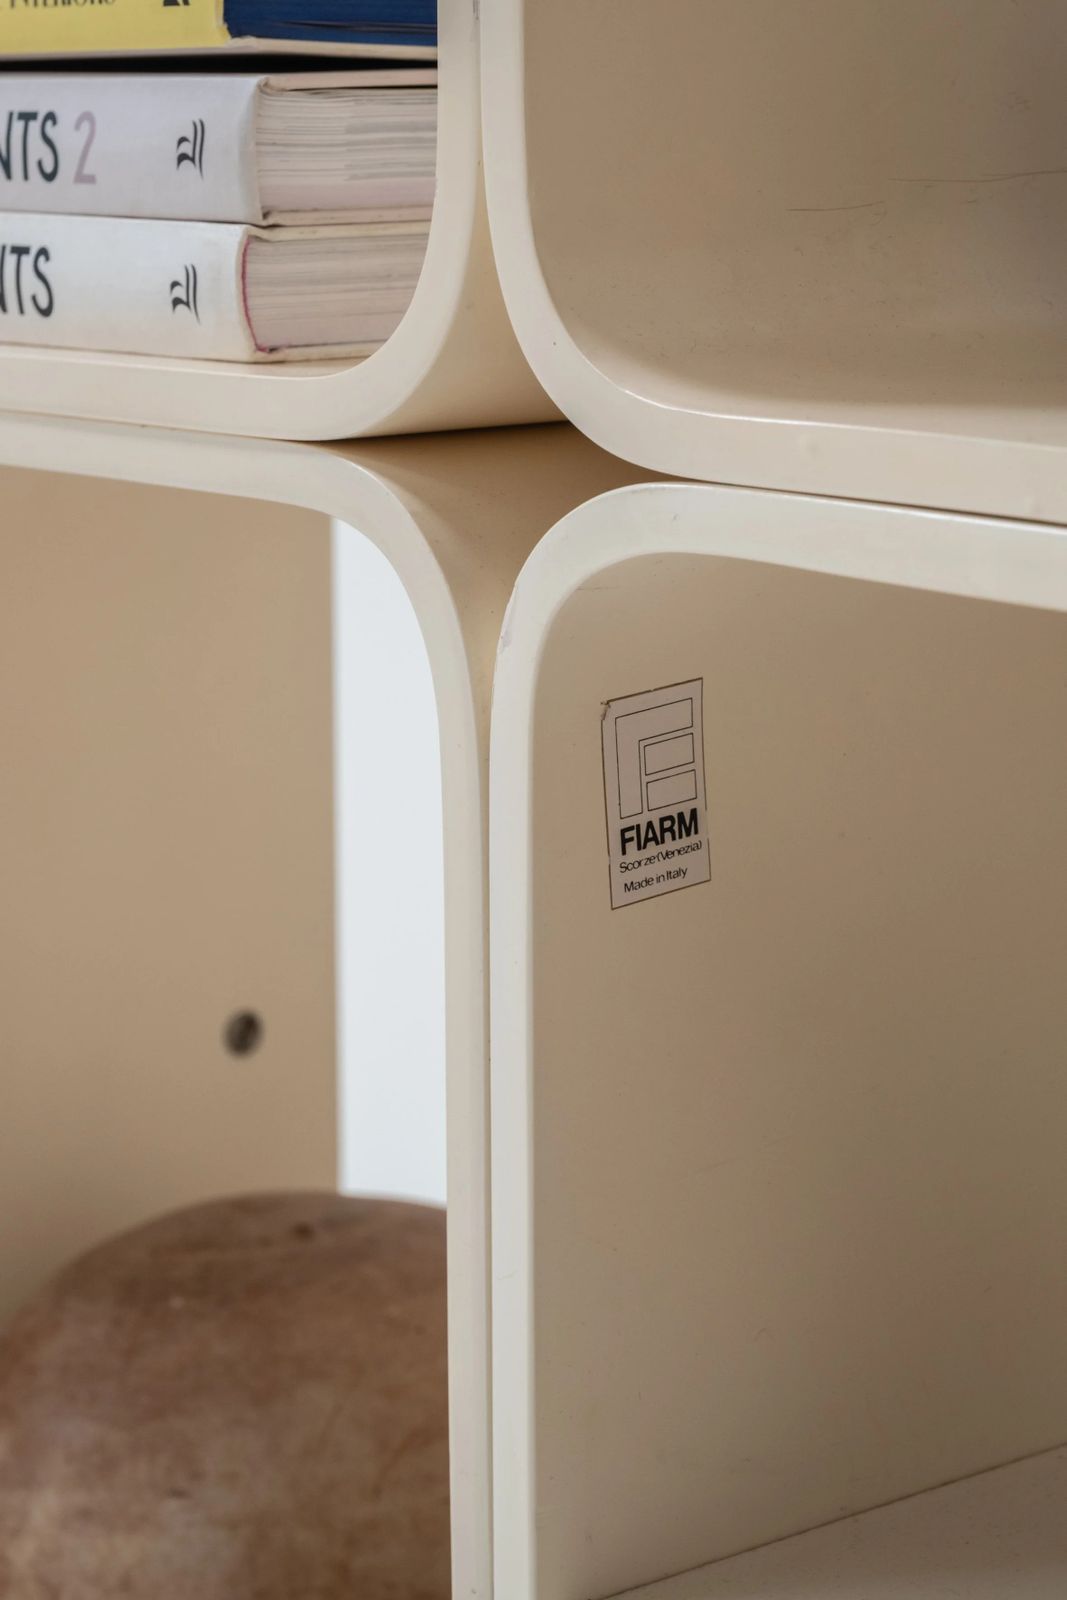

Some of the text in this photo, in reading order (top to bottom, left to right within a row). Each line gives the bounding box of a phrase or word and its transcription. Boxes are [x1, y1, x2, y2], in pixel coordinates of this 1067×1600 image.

[73, 110, 97, 185] 2
[620, 807, 699, 856] FIARM
[624, 867, 688, 893] Made in Italy
